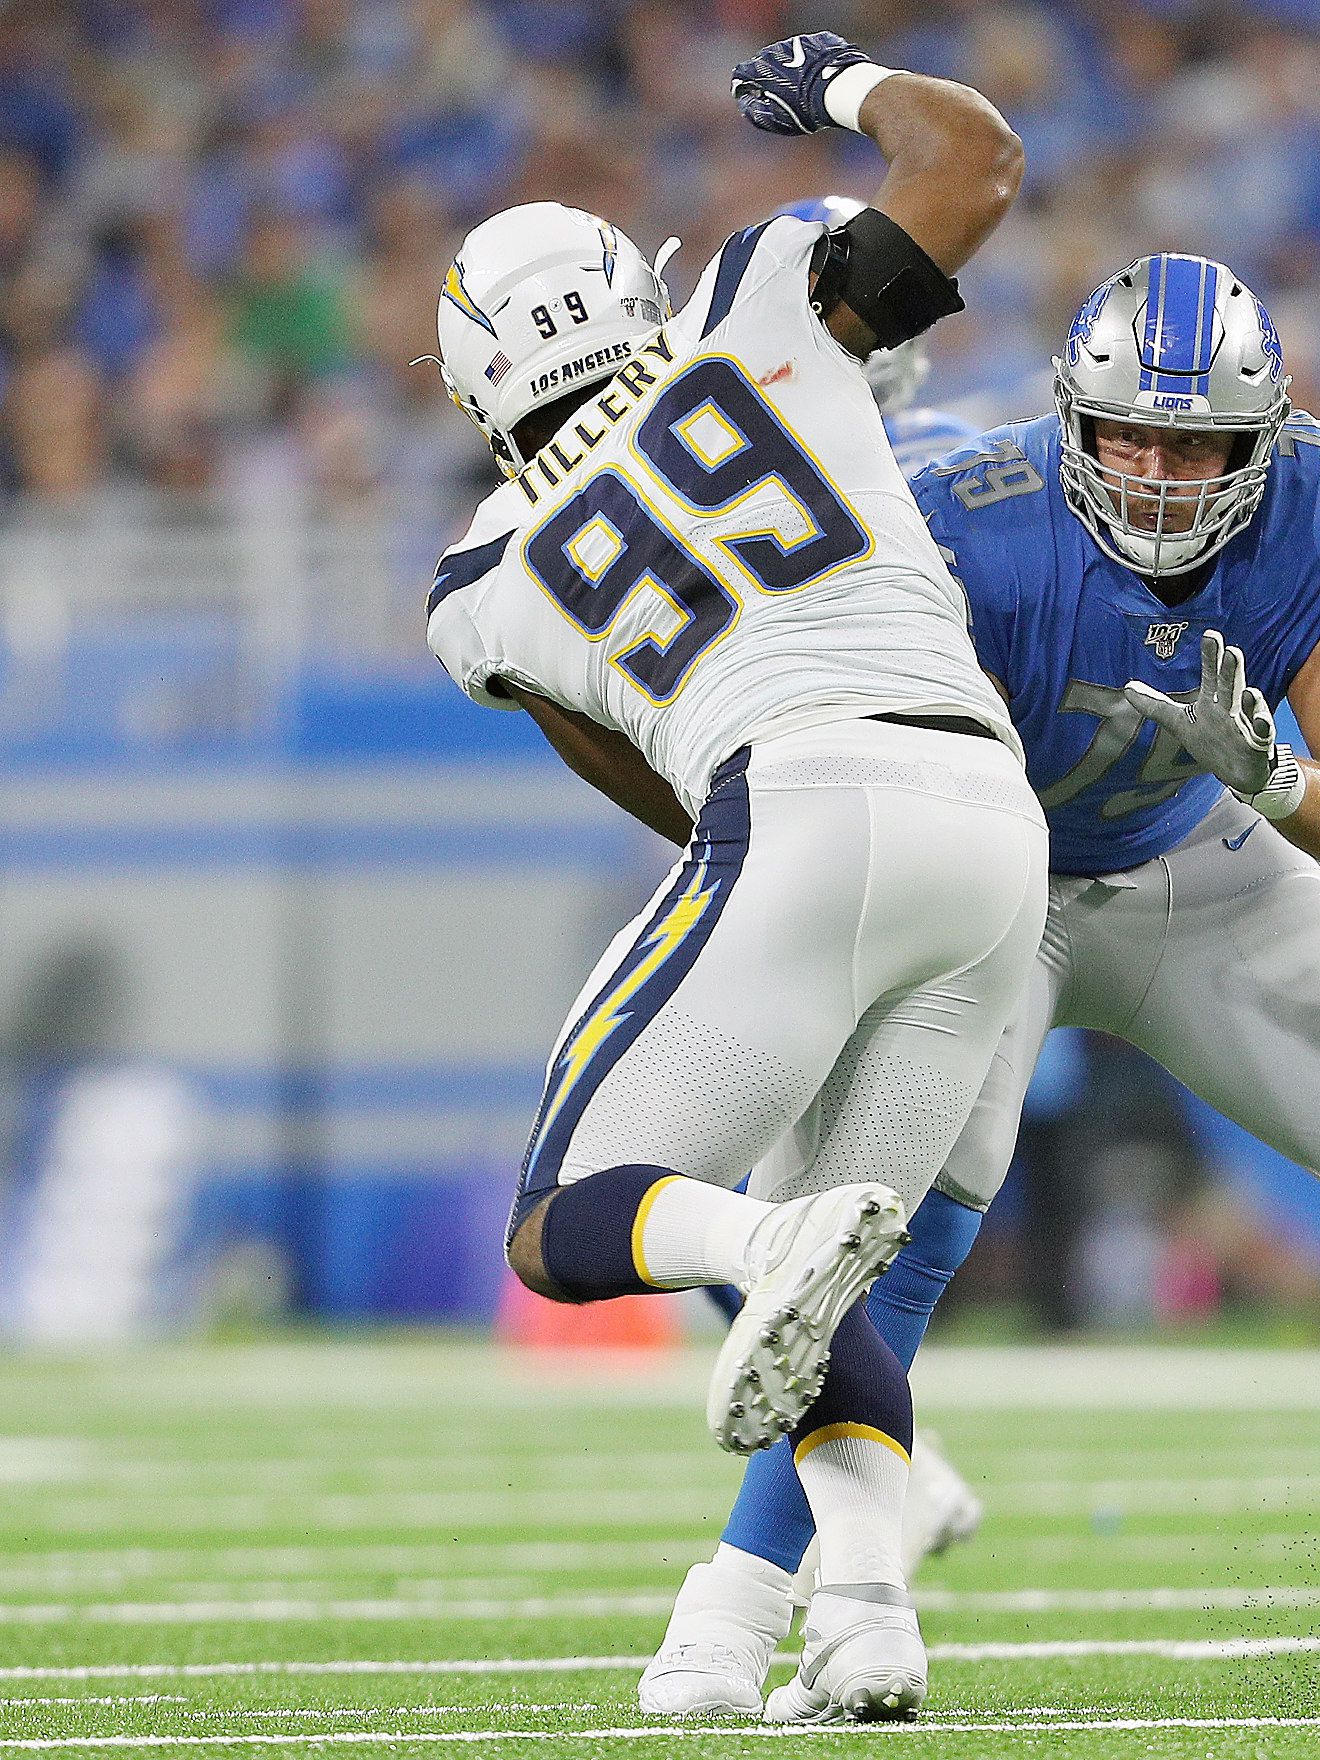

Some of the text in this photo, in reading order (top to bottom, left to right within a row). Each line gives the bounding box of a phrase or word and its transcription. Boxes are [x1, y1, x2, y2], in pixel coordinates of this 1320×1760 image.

[529, 341, 632, 397] LOS ANGELES
[1153, 395, 1193, 410] LIONS
[513, 329, 677, 505] TILLERY
[934, 438, 1047, 513] 79
[521, 352, 876, 709] 99
